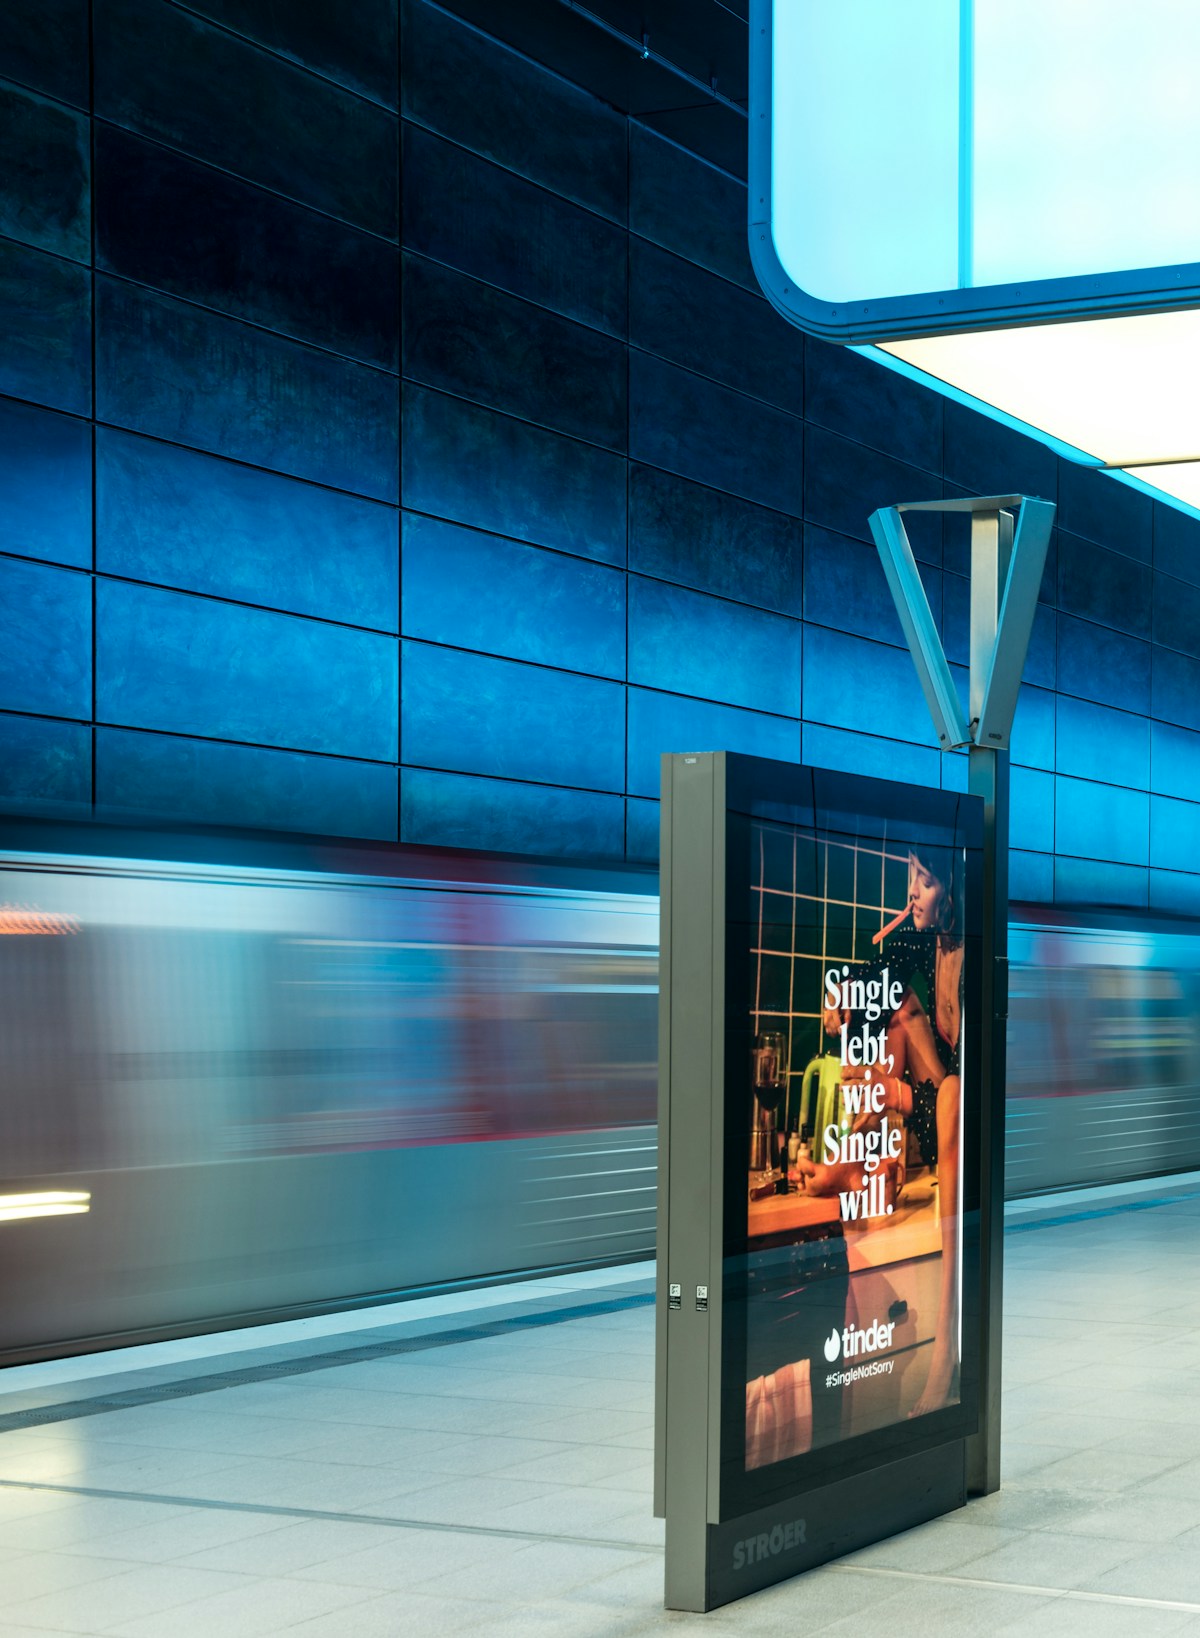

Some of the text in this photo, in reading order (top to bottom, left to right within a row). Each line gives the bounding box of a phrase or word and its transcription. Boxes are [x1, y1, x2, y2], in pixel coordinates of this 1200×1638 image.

[824, 965, 904, 1021] Single
[839, 1022, 895, 1074] lebt,
[842, 1070, 886, 1115] wie
[823, 1116, 902, 1173] Single
[839, 1172, 894, 1223] will.
[841, 1318, 896, 1359] tinder
[825, 1360, 895, 1388] #SingleNotSorry
[732, 1518, 807, 1570] STRÖER
